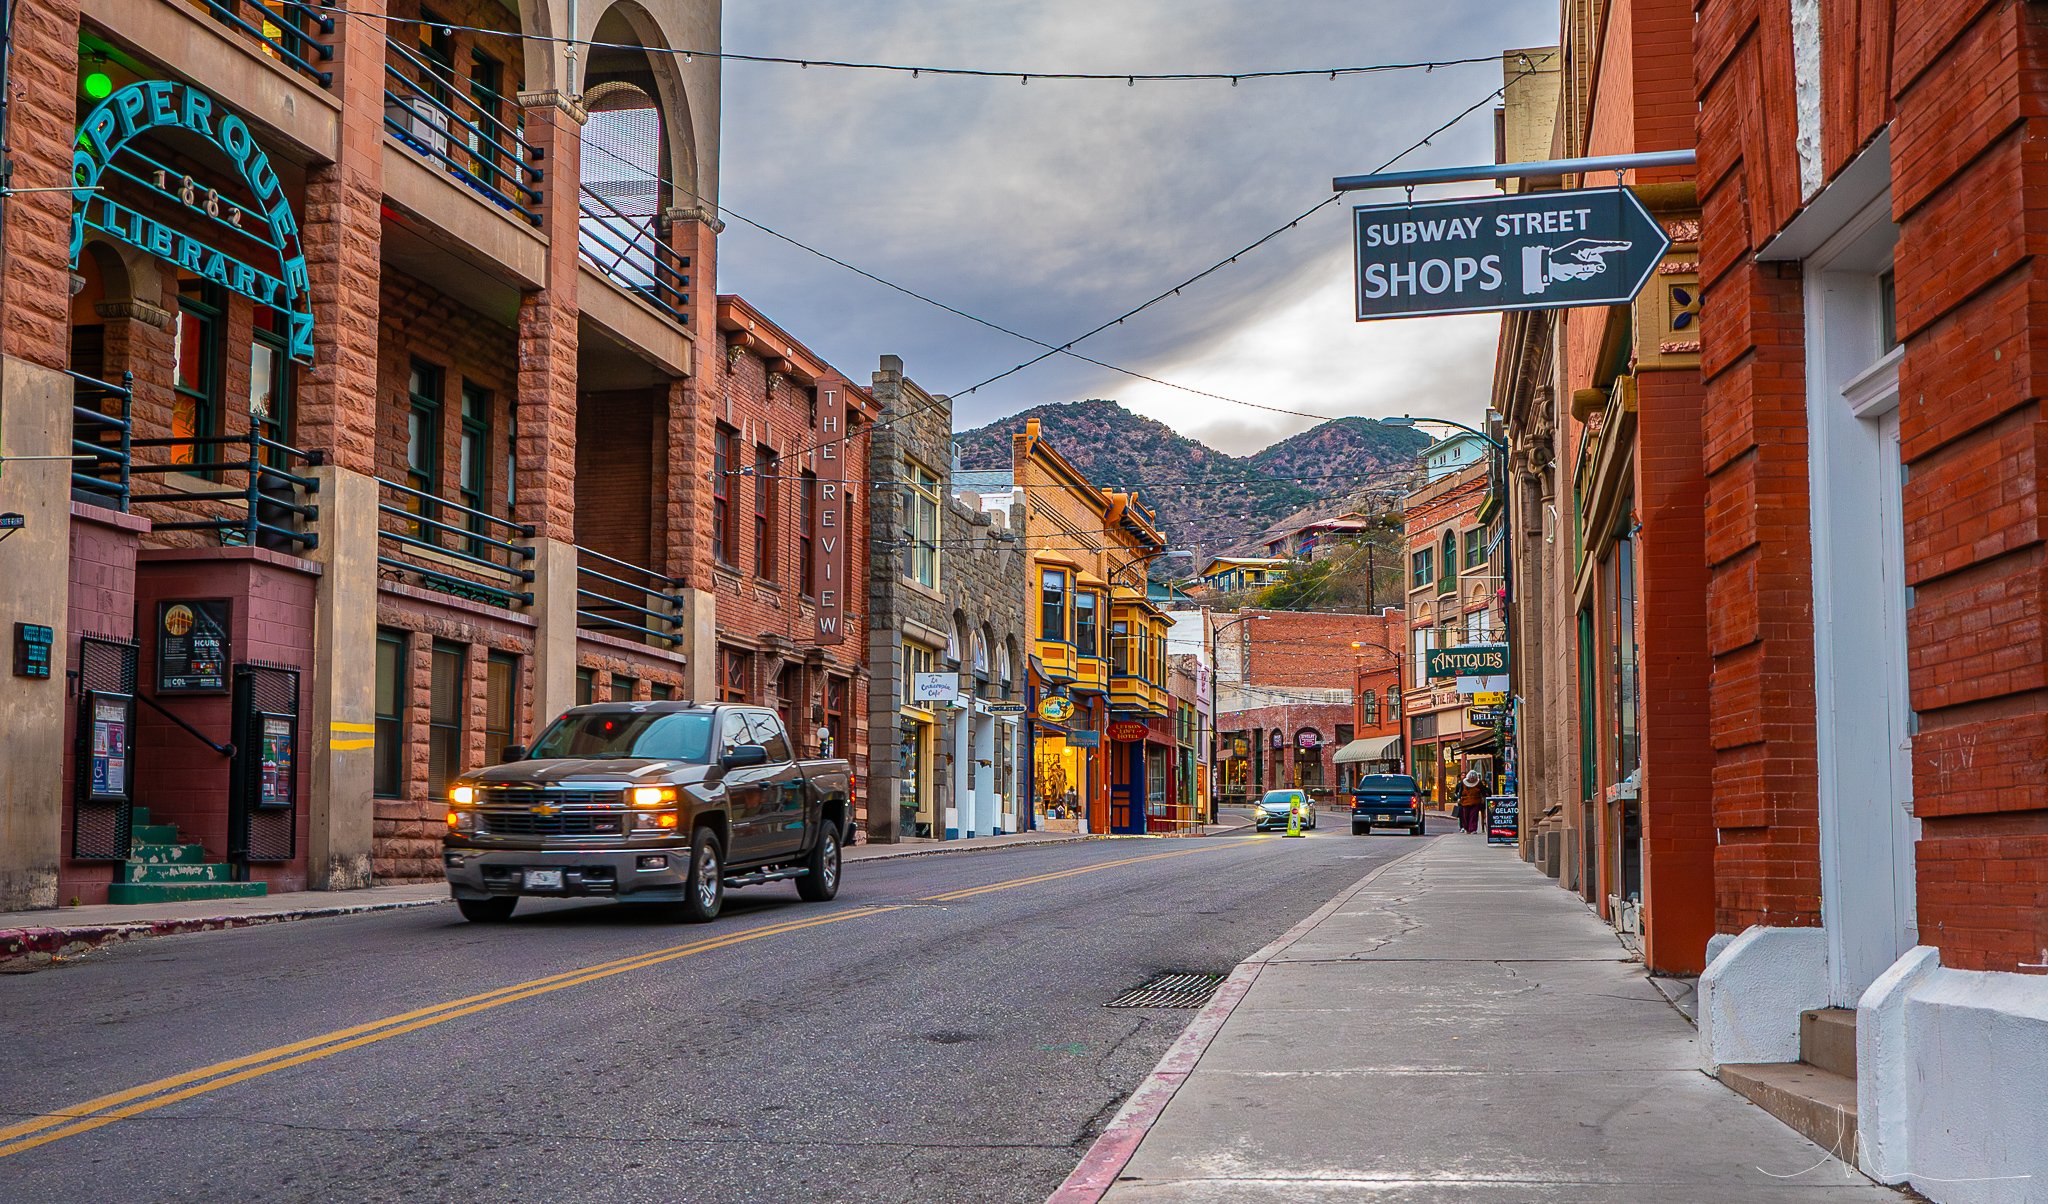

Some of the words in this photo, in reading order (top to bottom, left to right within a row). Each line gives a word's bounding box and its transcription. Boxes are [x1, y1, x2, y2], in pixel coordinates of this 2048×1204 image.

[153, 170, 242, 229] 1882
[1366, 216, 1483, 247] SUBWAY
[1495, 208, 1592, 237] STREET
[103, 200, 282, 304] LIBRARY
[217, 113, 315, 359] QUEEN
[1364, 254, 1503, 299] SHOPS
[823, 390, 837, 460] THE
[819, 484, 837, 634] REVIEW
[1432, 652, 1503, 673] ANTIQUES
